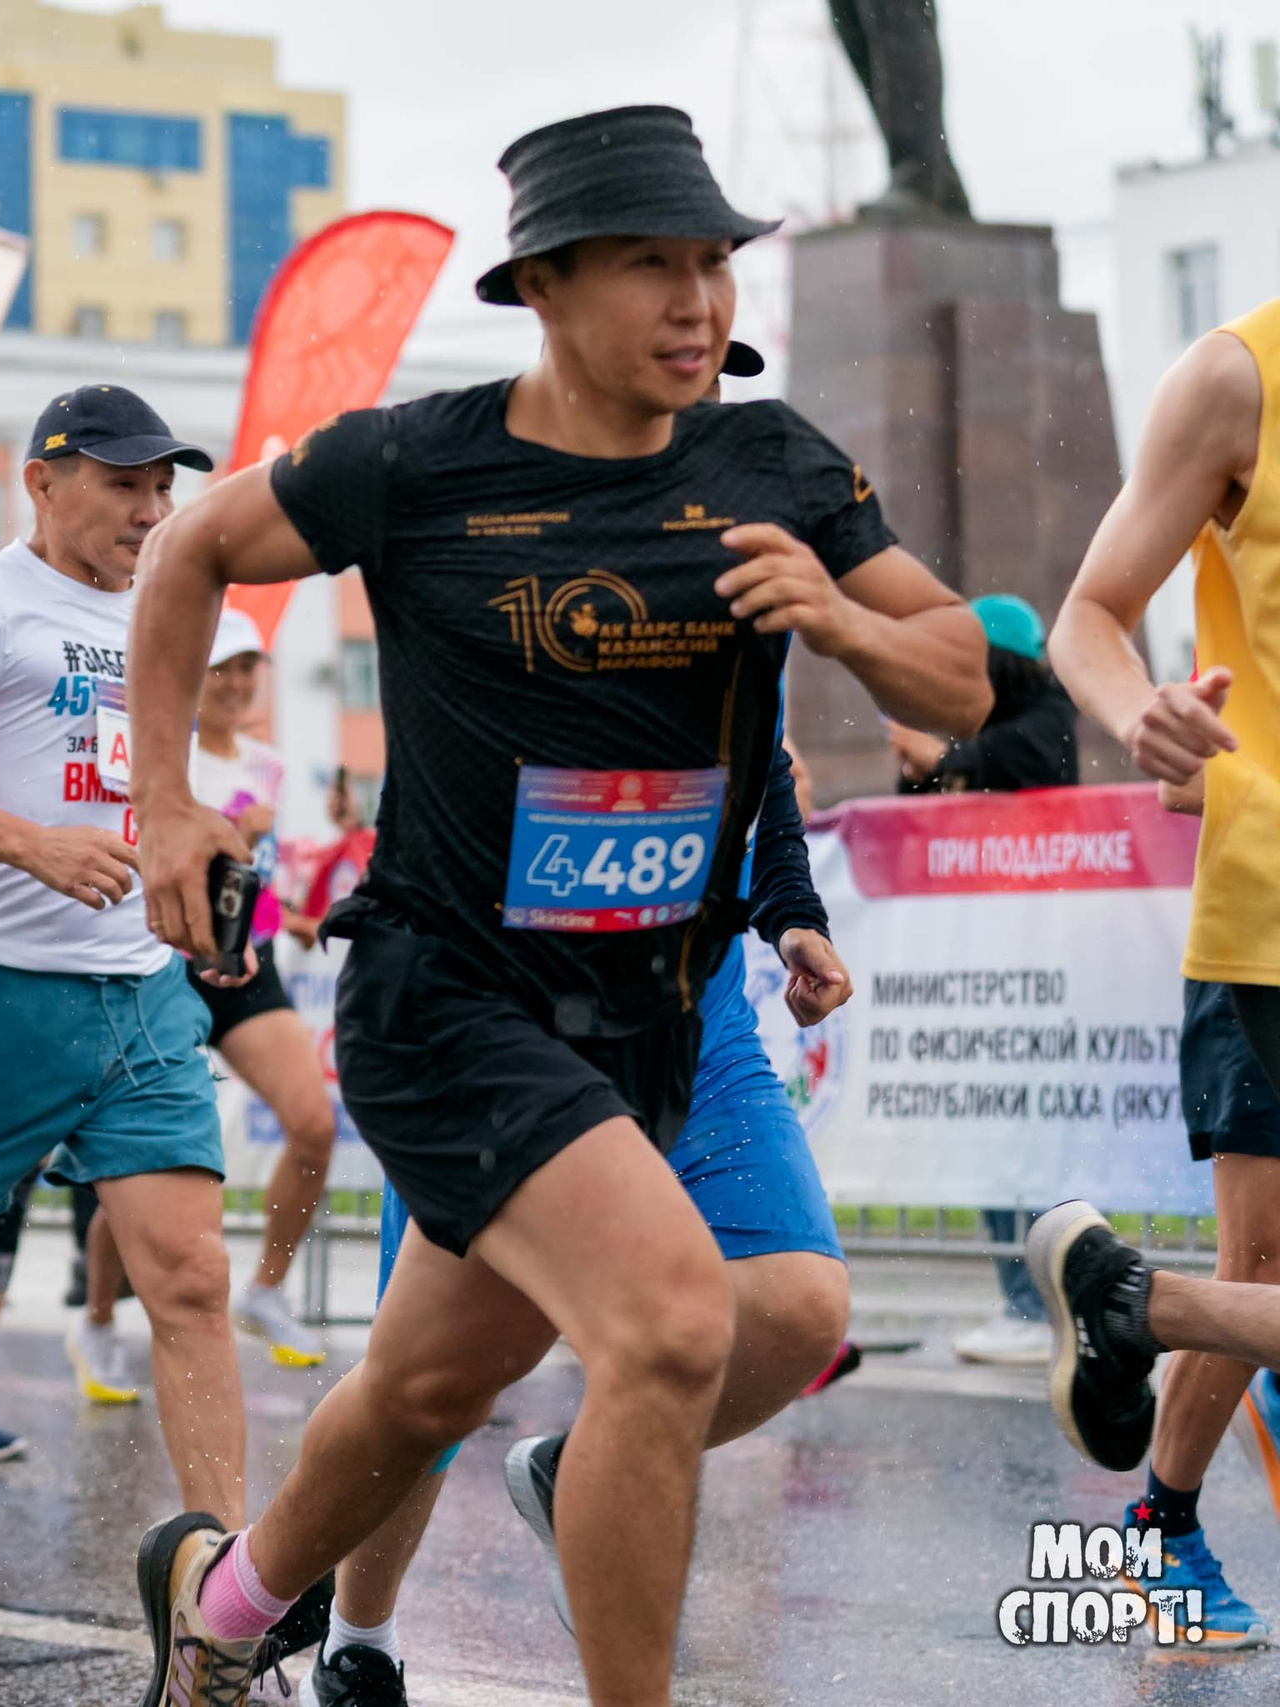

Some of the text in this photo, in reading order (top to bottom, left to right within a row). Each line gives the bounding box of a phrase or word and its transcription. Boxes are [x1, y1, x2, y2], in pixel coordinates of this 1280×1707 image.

[597, 638, 718, 656] КАЗАНСКИЙ
[684, 620, 736, 637] БАНК
[526, 832, 706, 897] 4489
[927, 830, 1133, 878] ПРИ ПОДДЕРЖКЕ
[529, 911, 597, 929] Skintime
[872, 970, 1066, 1006] МИНИСТЕРСТВО
[870, 1027, 901, 1063] ПО
[908, 1018, 1077, 1063] ФИЗИЧЕСКОЙ
[868, 1082, 1030, 1120] РЕСПУБЛИКИ
[1038, 1081, 1102, 1120] САХА
